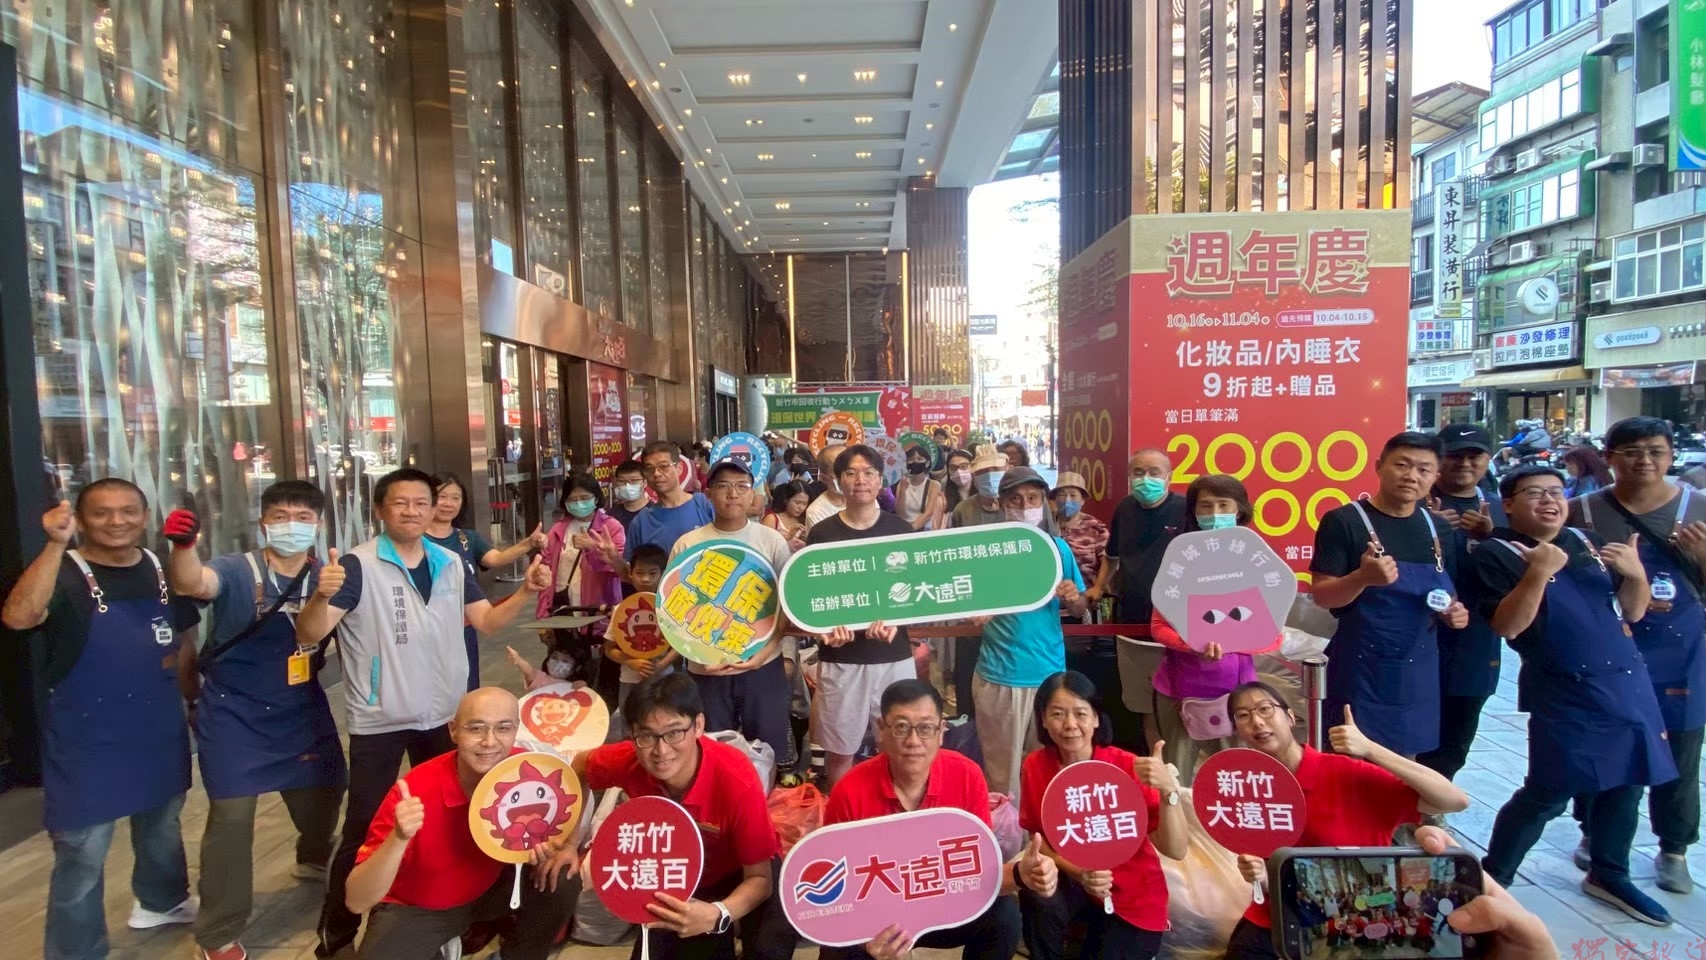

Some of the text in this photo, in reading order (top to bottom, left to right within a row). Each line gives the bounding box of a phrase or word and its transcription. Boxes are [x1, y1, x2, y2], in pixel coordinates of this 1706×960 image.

[1441, 186, 1461, 301] 東昇裝潢行
[1165, 226, 1370, 298] 週年慶
[1316, 312, 1368, 322] 10.04-10.15
[1176, 337, 1361, 368] 化妝品/內睡衣
[1520, 327, 1570, 345] 沙發修理
[1495, 349, 1517, 363] 拉門
[1202, 372, 1336, 399] 9折起+贈品
[1064, 409, 1113, 452] 6000
[1165, 408, 1239, 424] 當日單筆滿
[1166, 430, 1368, 484] 2000
[807, 539, 1032, 577] 主辦單位 新竹市環境保護局
[685, 549, 773, 624] 環保
[811, 574, 973, 612] 協辦單位 大遠百
[392, 586, 408, 645] 環境保護局
[662, 582, 757, 655] 做伙來
[1065, 781, 1119, 815] 新竹
[1216, 769, 1275, 798] 新竹
[1056, 811, 1138, 848] 大遠百
[1206, 800, 1294, 832] 大遠百
[617, 821, 675, 854] 新竹
[601, 857, 689, 891] 大遠百
[855, 834, 984, 902] 大遠百
